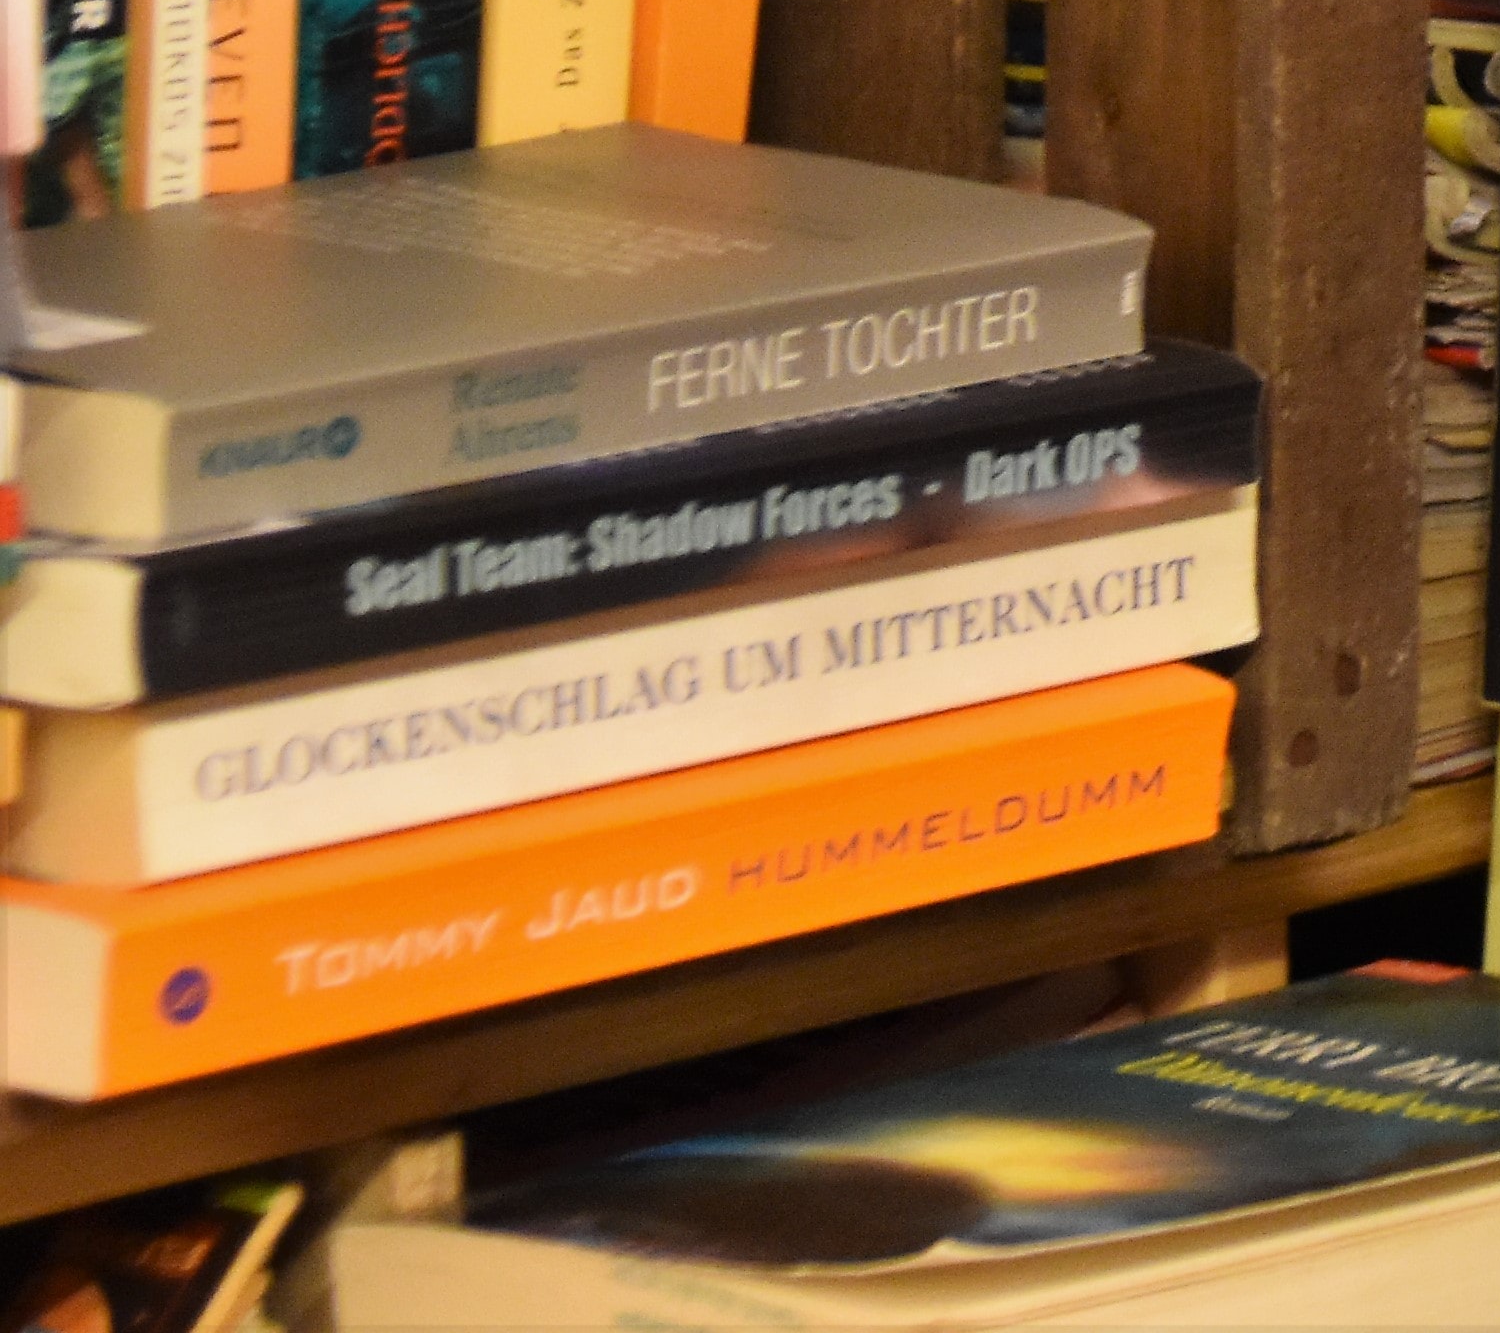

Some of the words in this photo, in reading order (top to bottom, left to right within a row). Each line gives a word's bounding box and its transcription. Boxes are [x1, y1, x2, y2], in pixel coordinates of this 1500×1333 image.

[648, 340, 803, 417] FERNE
[820, 286, 1039, 382] TOCHTER
[197, 652, 702, 804] GLOCKENSCHLAG
[722, 631, 803, 694] UM
[820, 553, 1197, 674] MITTERNACHT
[275, 905, 502, 997] TOMMY
[527, 862, 702, 943] JAUD
[728, 763, 1169, 895] HUMMELDUMM
